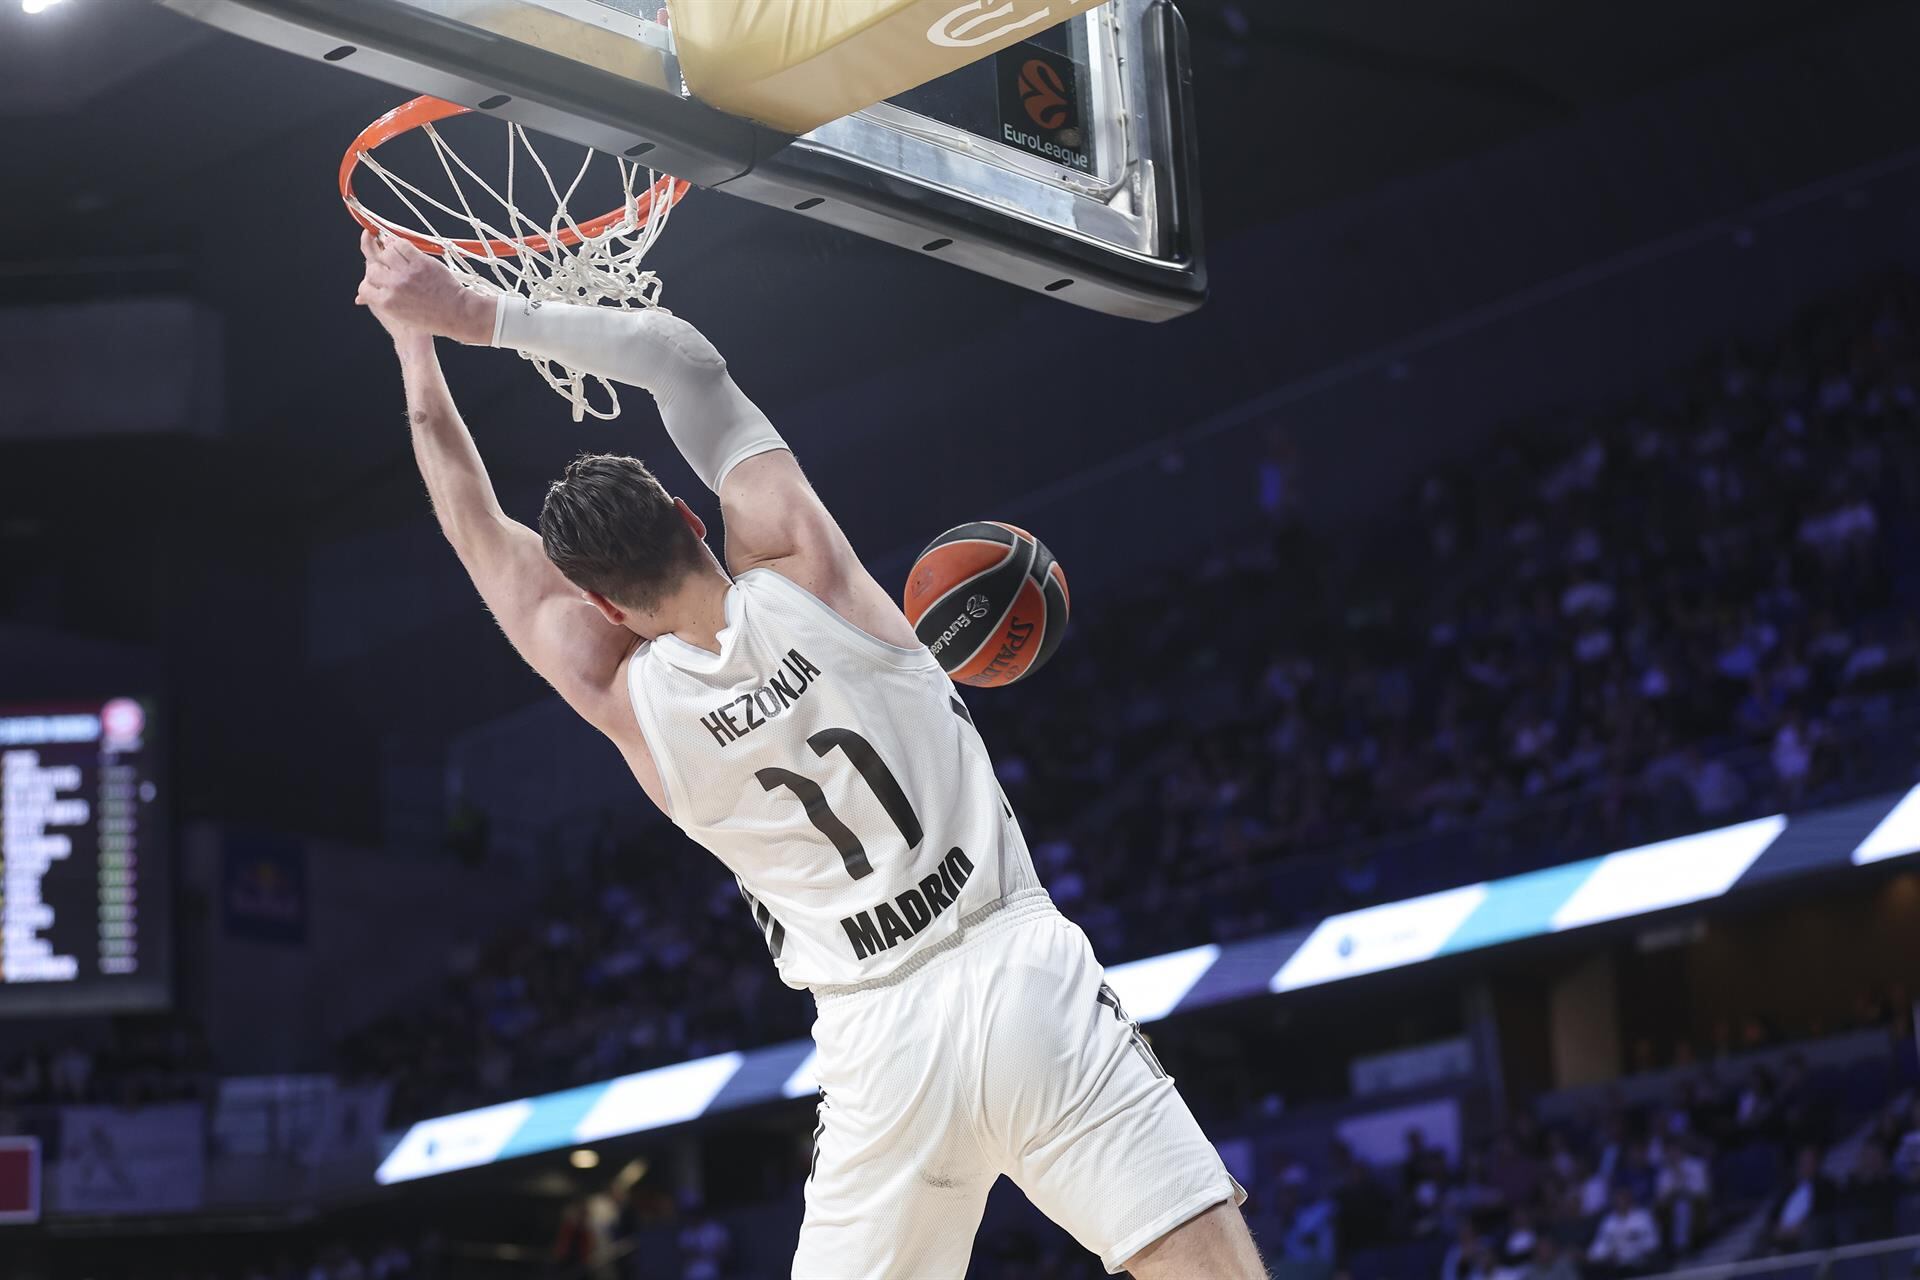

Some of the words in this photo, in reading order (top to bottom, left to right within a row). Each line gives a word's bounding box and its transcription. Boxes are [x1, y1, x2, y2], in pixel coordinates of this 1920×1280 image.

[1003, 123, 1088, 168] EuroLeague
[700, 648, 821, 747] HEZONJA
[966, 615, 1035, 685] SPALDI
[755, 728, 924, 881] 11
[840, 846, 975, 961] MADRID
